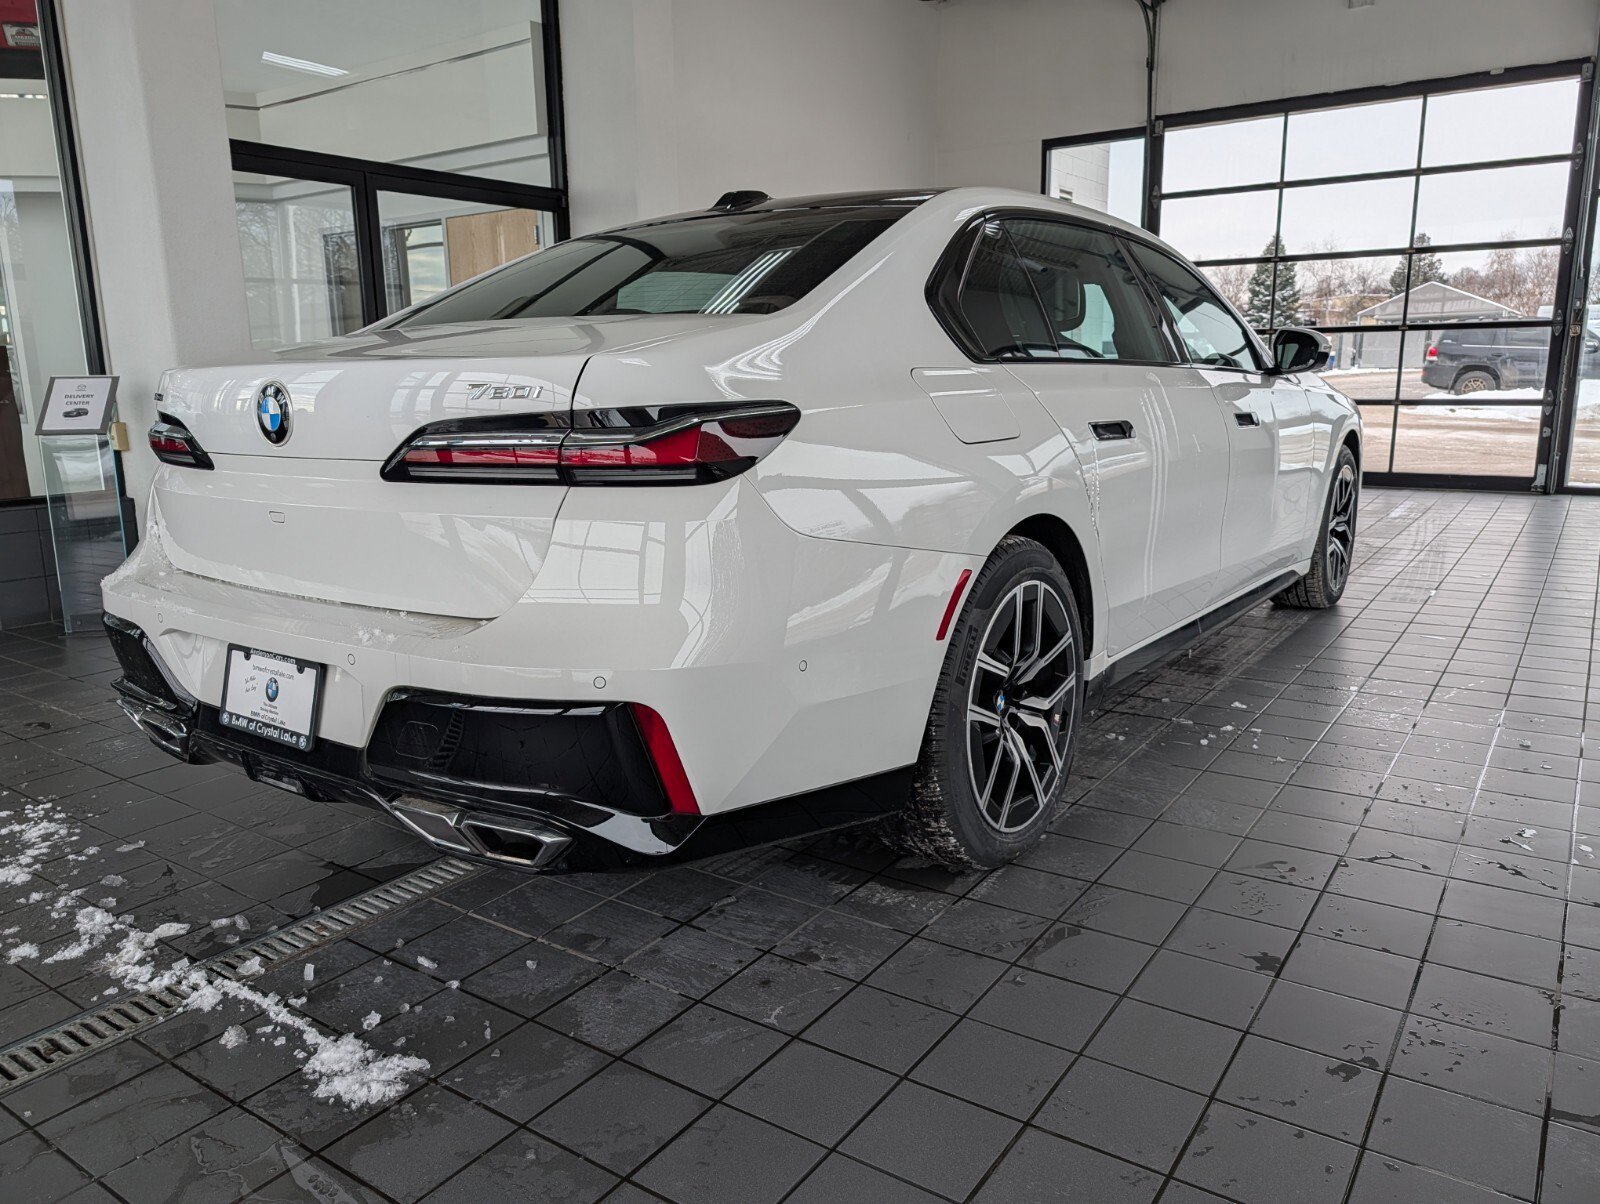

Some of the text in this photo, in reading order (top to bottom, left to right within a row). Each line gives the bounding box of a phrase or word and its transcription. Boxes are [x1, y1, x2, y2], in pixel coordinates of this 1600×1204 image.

[955, 625, 979, 686] PIRELLI
[231, 714, 297, 744] BMW of Crystal Lake
[265, 714, 277, 723] Crystal
